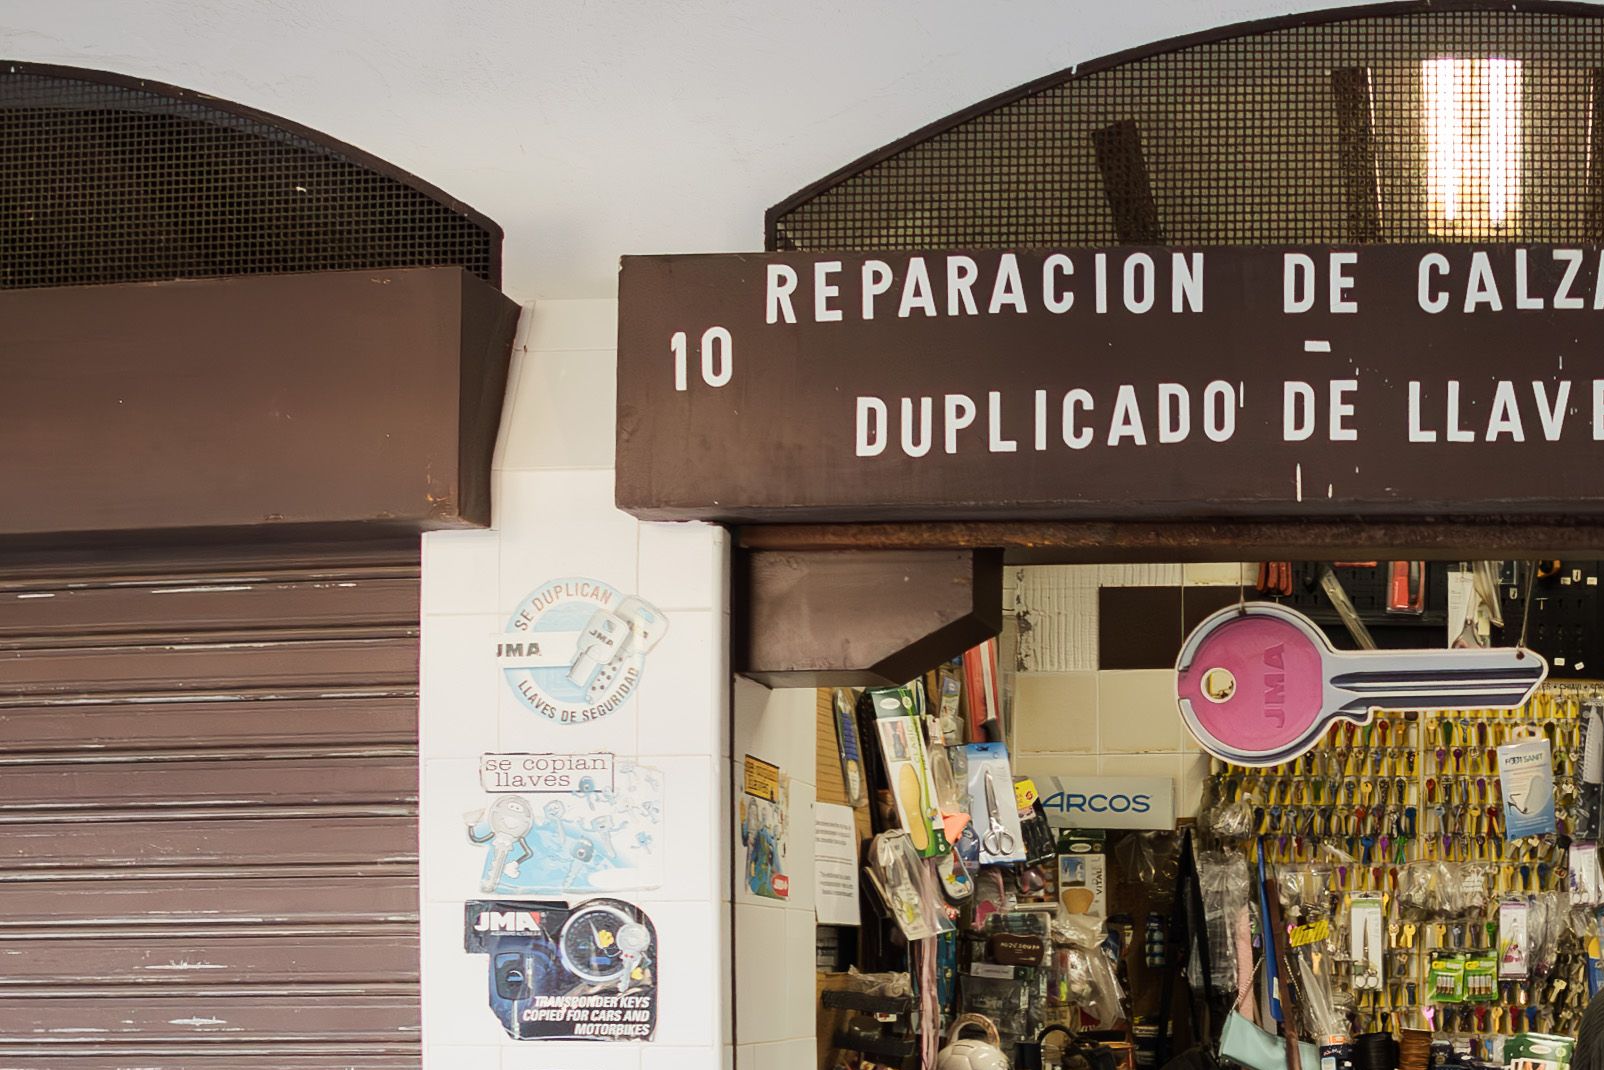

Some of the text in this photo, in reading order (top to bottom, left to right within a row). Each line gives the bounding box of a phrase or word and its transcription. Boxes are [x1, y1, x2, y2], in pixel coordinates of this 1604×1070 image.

[766, 252, 1204, 324] REPARACION
[1283, 252, 1358, 313] DE
[671, 326, 733, 391] 10
[855, 380, 1236, 457] DUPLICADO
[1283, 380, 1358, 441] DE
[514, 582, 613, 632] SE DUPLICAN
[496, 642, 541, 658] JMA
[517, 666, 640, 724] LLAVES DE SEGURIDAD
[1263, 641, 1286, 729] JMA
[485, 756, 608, 774] se copian
[495, 771, 571, 788] llaves
[1041, 791, 1151, 813] ARCOS
[474, 911, 541, 932] JMA
[534, 996, 650, 1009] TRANSPONDER KEYS
[523, 1009, 650, 1022] COPIED FOR CARS AND
[574, 1023, 650, 1036] MOTORBIKES
